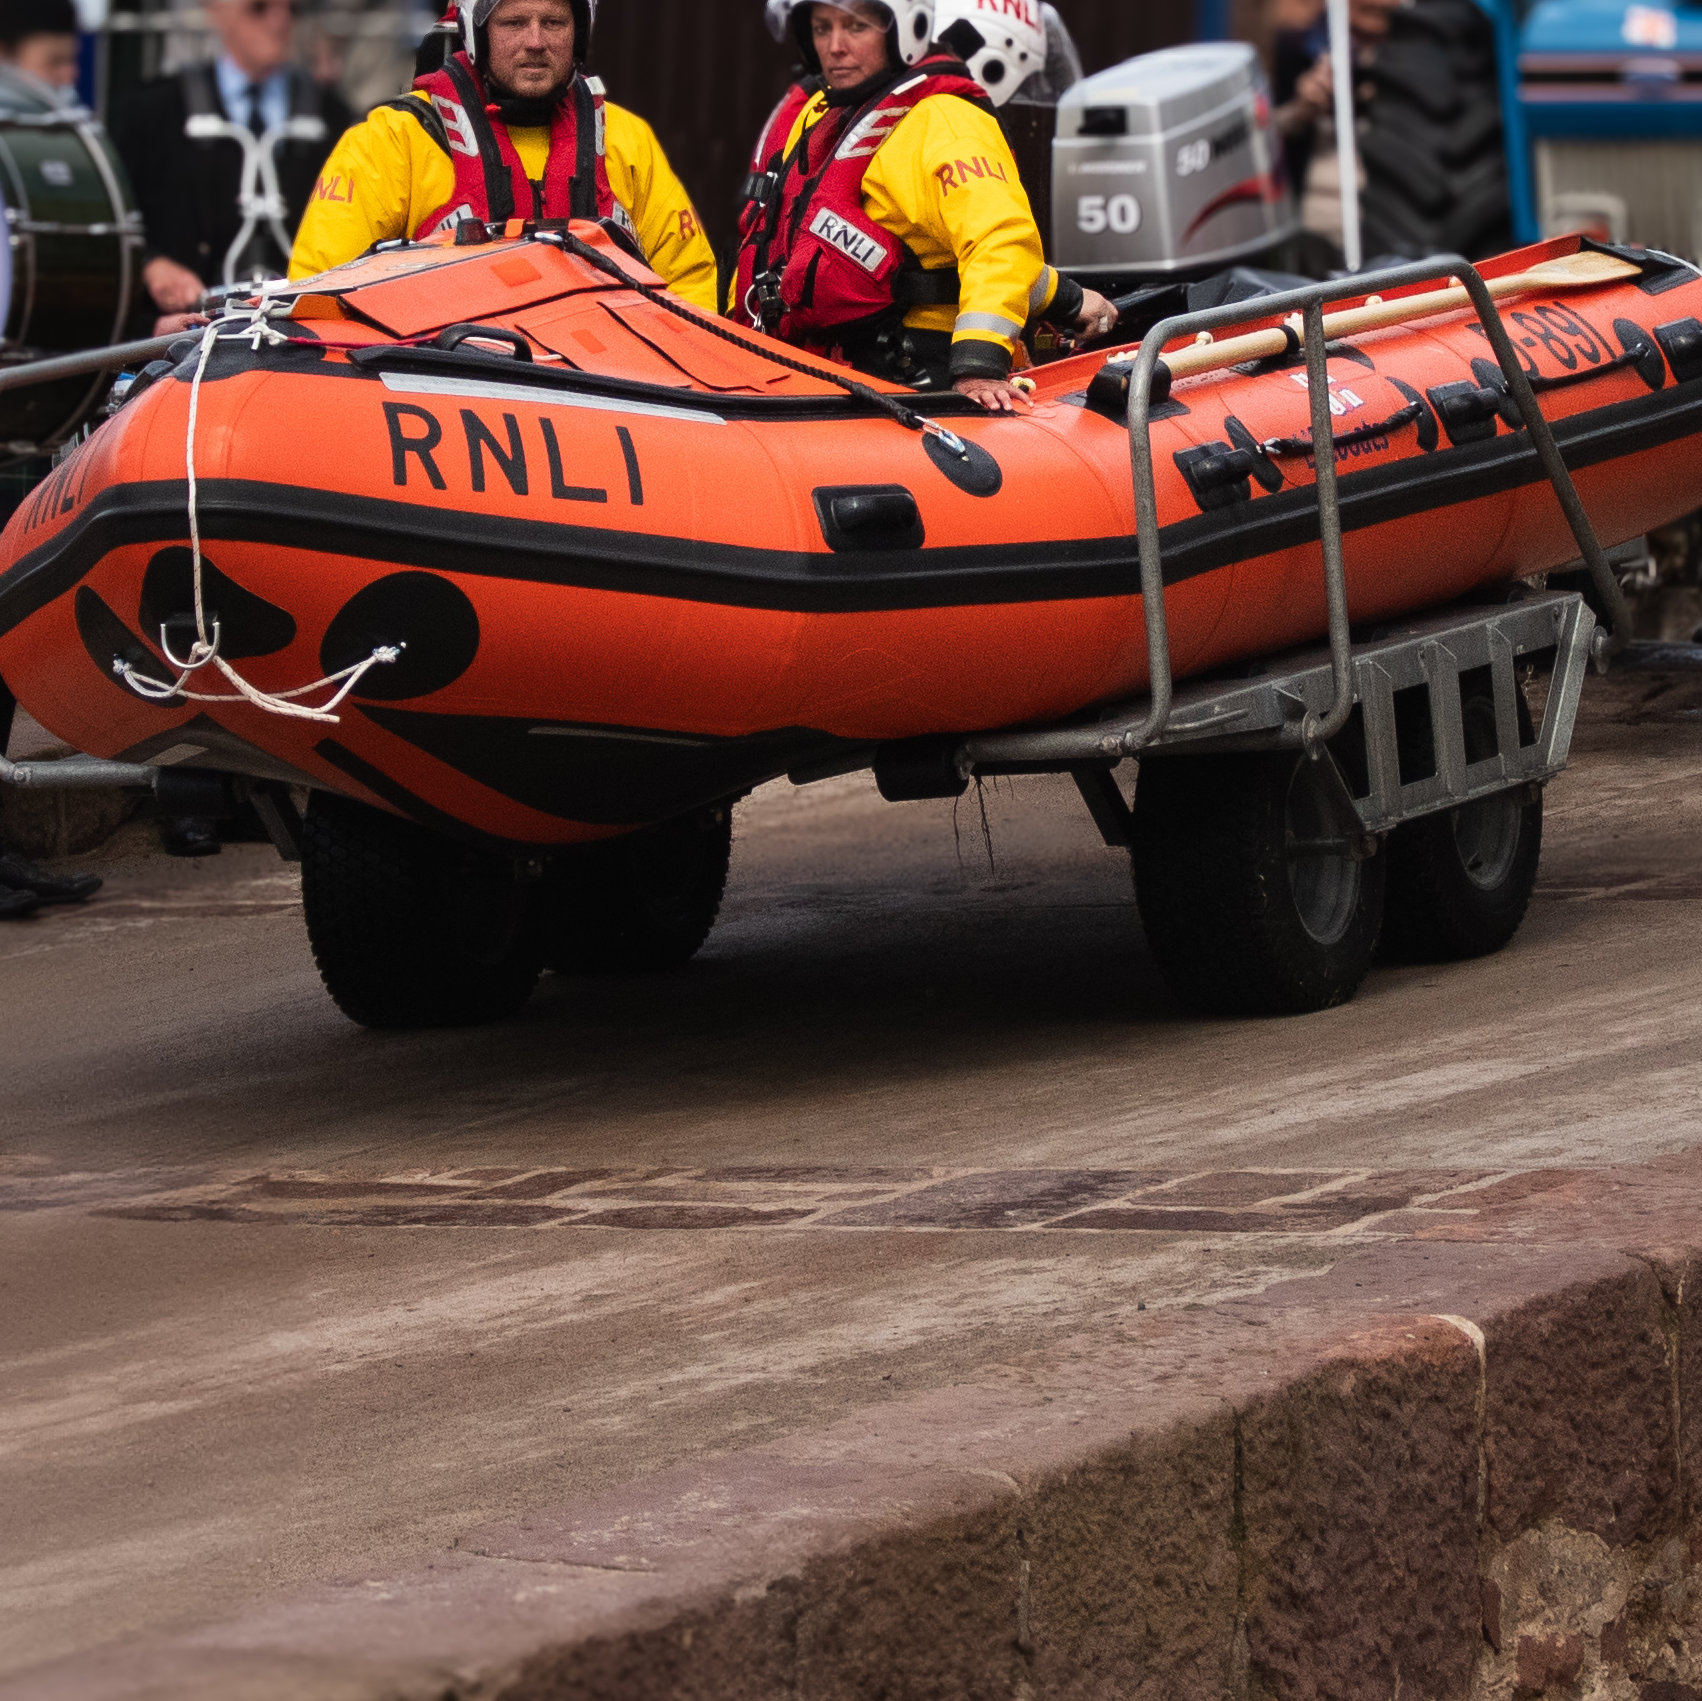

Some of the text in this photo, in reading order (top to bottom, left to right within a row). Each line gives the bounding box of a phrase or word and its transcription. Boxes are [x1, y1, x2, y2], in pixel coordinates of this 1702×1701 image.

[314, 175, 355, 204] NLI
[936, 155, 1008, 198] RNLI
[1076, 193, 1142, 235] 50
[817, 214, 877, 264] RNLI
[382, 400, 644, 506] RNLI
